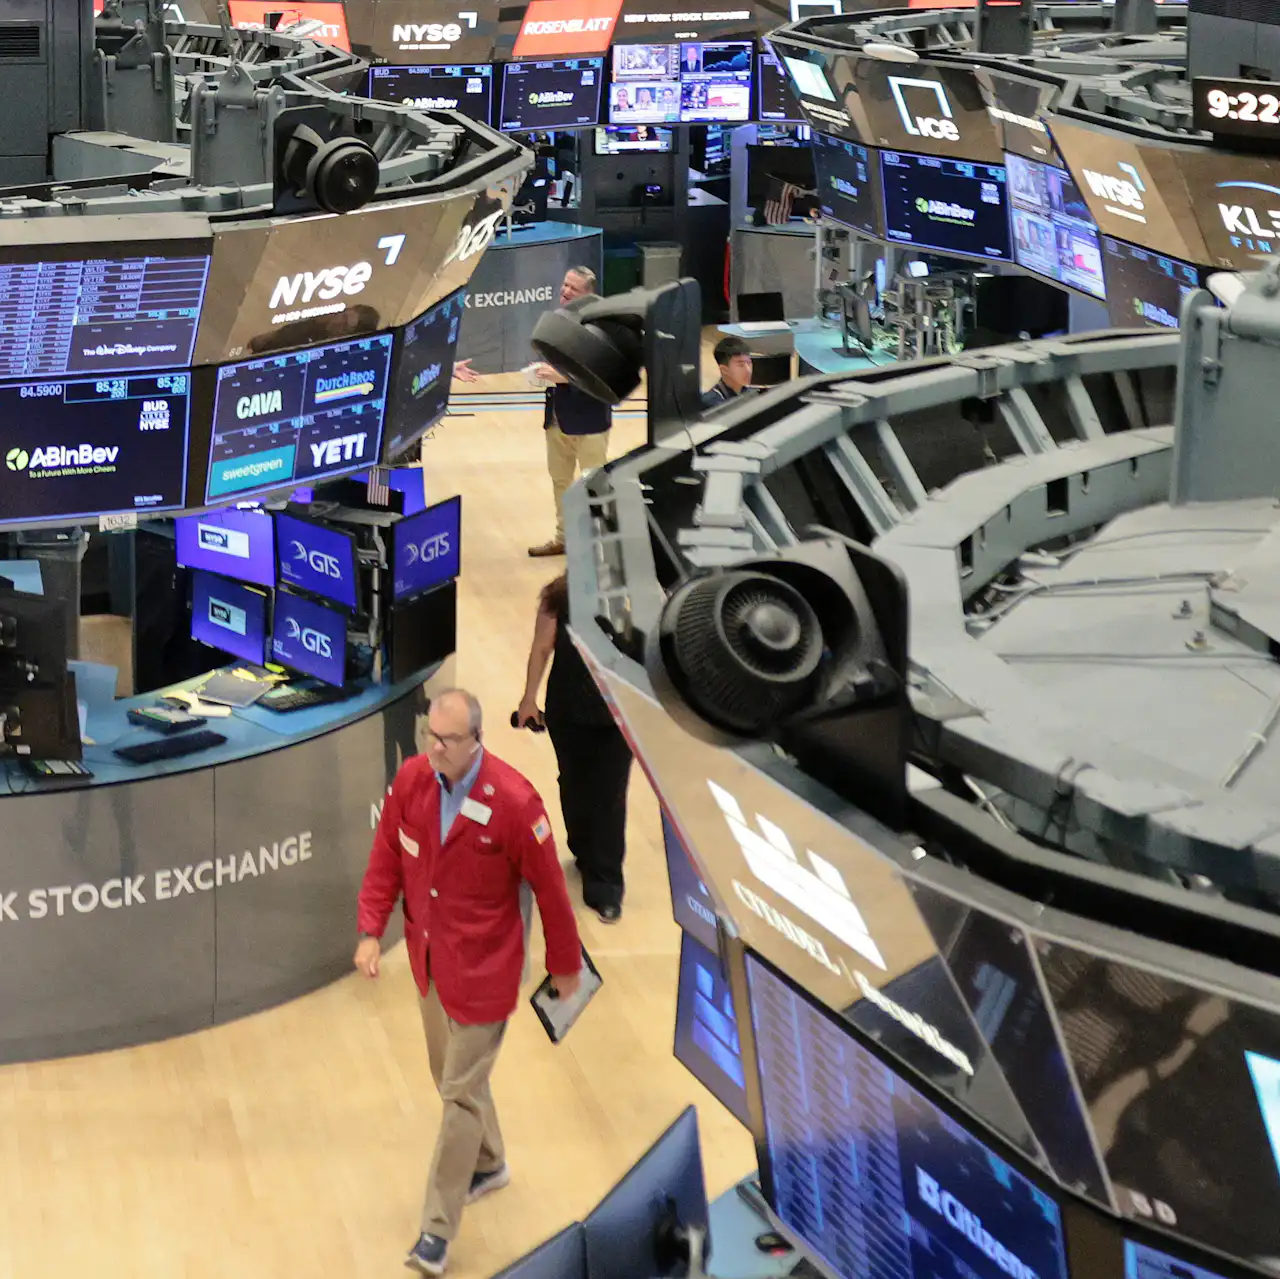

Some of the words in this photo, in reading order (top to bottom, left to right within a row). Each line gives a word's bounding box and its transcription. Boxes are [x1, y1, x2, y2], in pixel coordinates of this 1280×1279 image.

[524, 17, 612, 35] ROSENBLATT
[475, 286, 553, 308] EXCHANGE
[20, 385, 62, 398] 84.5900
[96, 380, 126, 393] 85.23
[157, 376, 186, 388] 85.28
[143, 400, 168, 411] BUD
[236, 389, 283, 420] CAVA
[140, 419, 170, 431] NYSE
[29, 444, 119, 469] ABInBev
[310, 432, 368, 467] YETI
[222, 458, 283, 481] sweetgreen
[420, 532, 451, 563] GTS
[309, 551, 342, 580] GTS
[301, 628, 332, 659] GTS
[28, 874, 146, 919] STOCK
[154, 830, 314, 901] EXCHANGE
